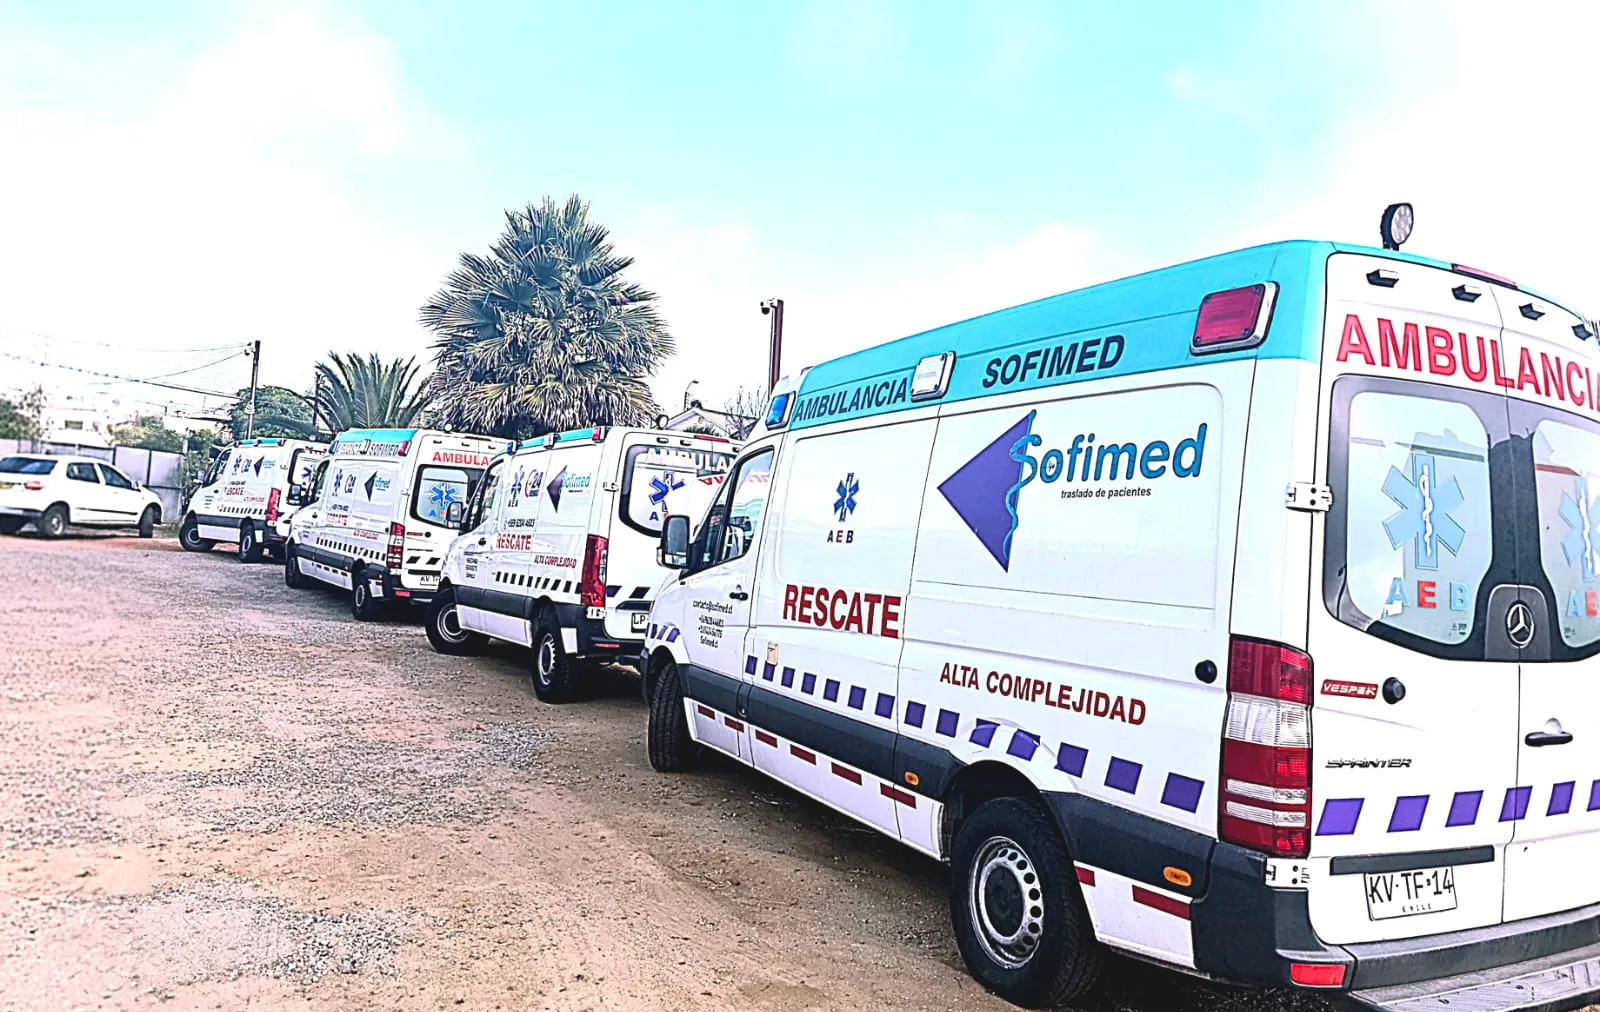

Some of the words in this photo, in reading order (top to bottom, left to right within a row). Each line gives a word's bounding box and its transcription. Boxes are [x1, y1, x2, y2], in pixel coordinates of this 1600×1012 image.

[793, 377, 908, 423] AMBULANCIA
[982, 335, 1125, 389] SOFIMED
[432, 452, 490, 466] AMBULA
[645, 447, 735, 474] AMBULA
[1012, 422, 1208, 485] Sofimed
[1061, 488, 1093, 499] traslado
[1095, 487, 1106, 498] de
[1107, 486, 1151, 499] pacientes
[496, 532, 531, 550] RESCATE
[782, 584, 902, 640] RESCATE
[939, 661, 979, 690] ALTA
[986, 670, 1147, 726] COMPLEJIDAD
[1325, 758, 1413, 769] SPRINTER
